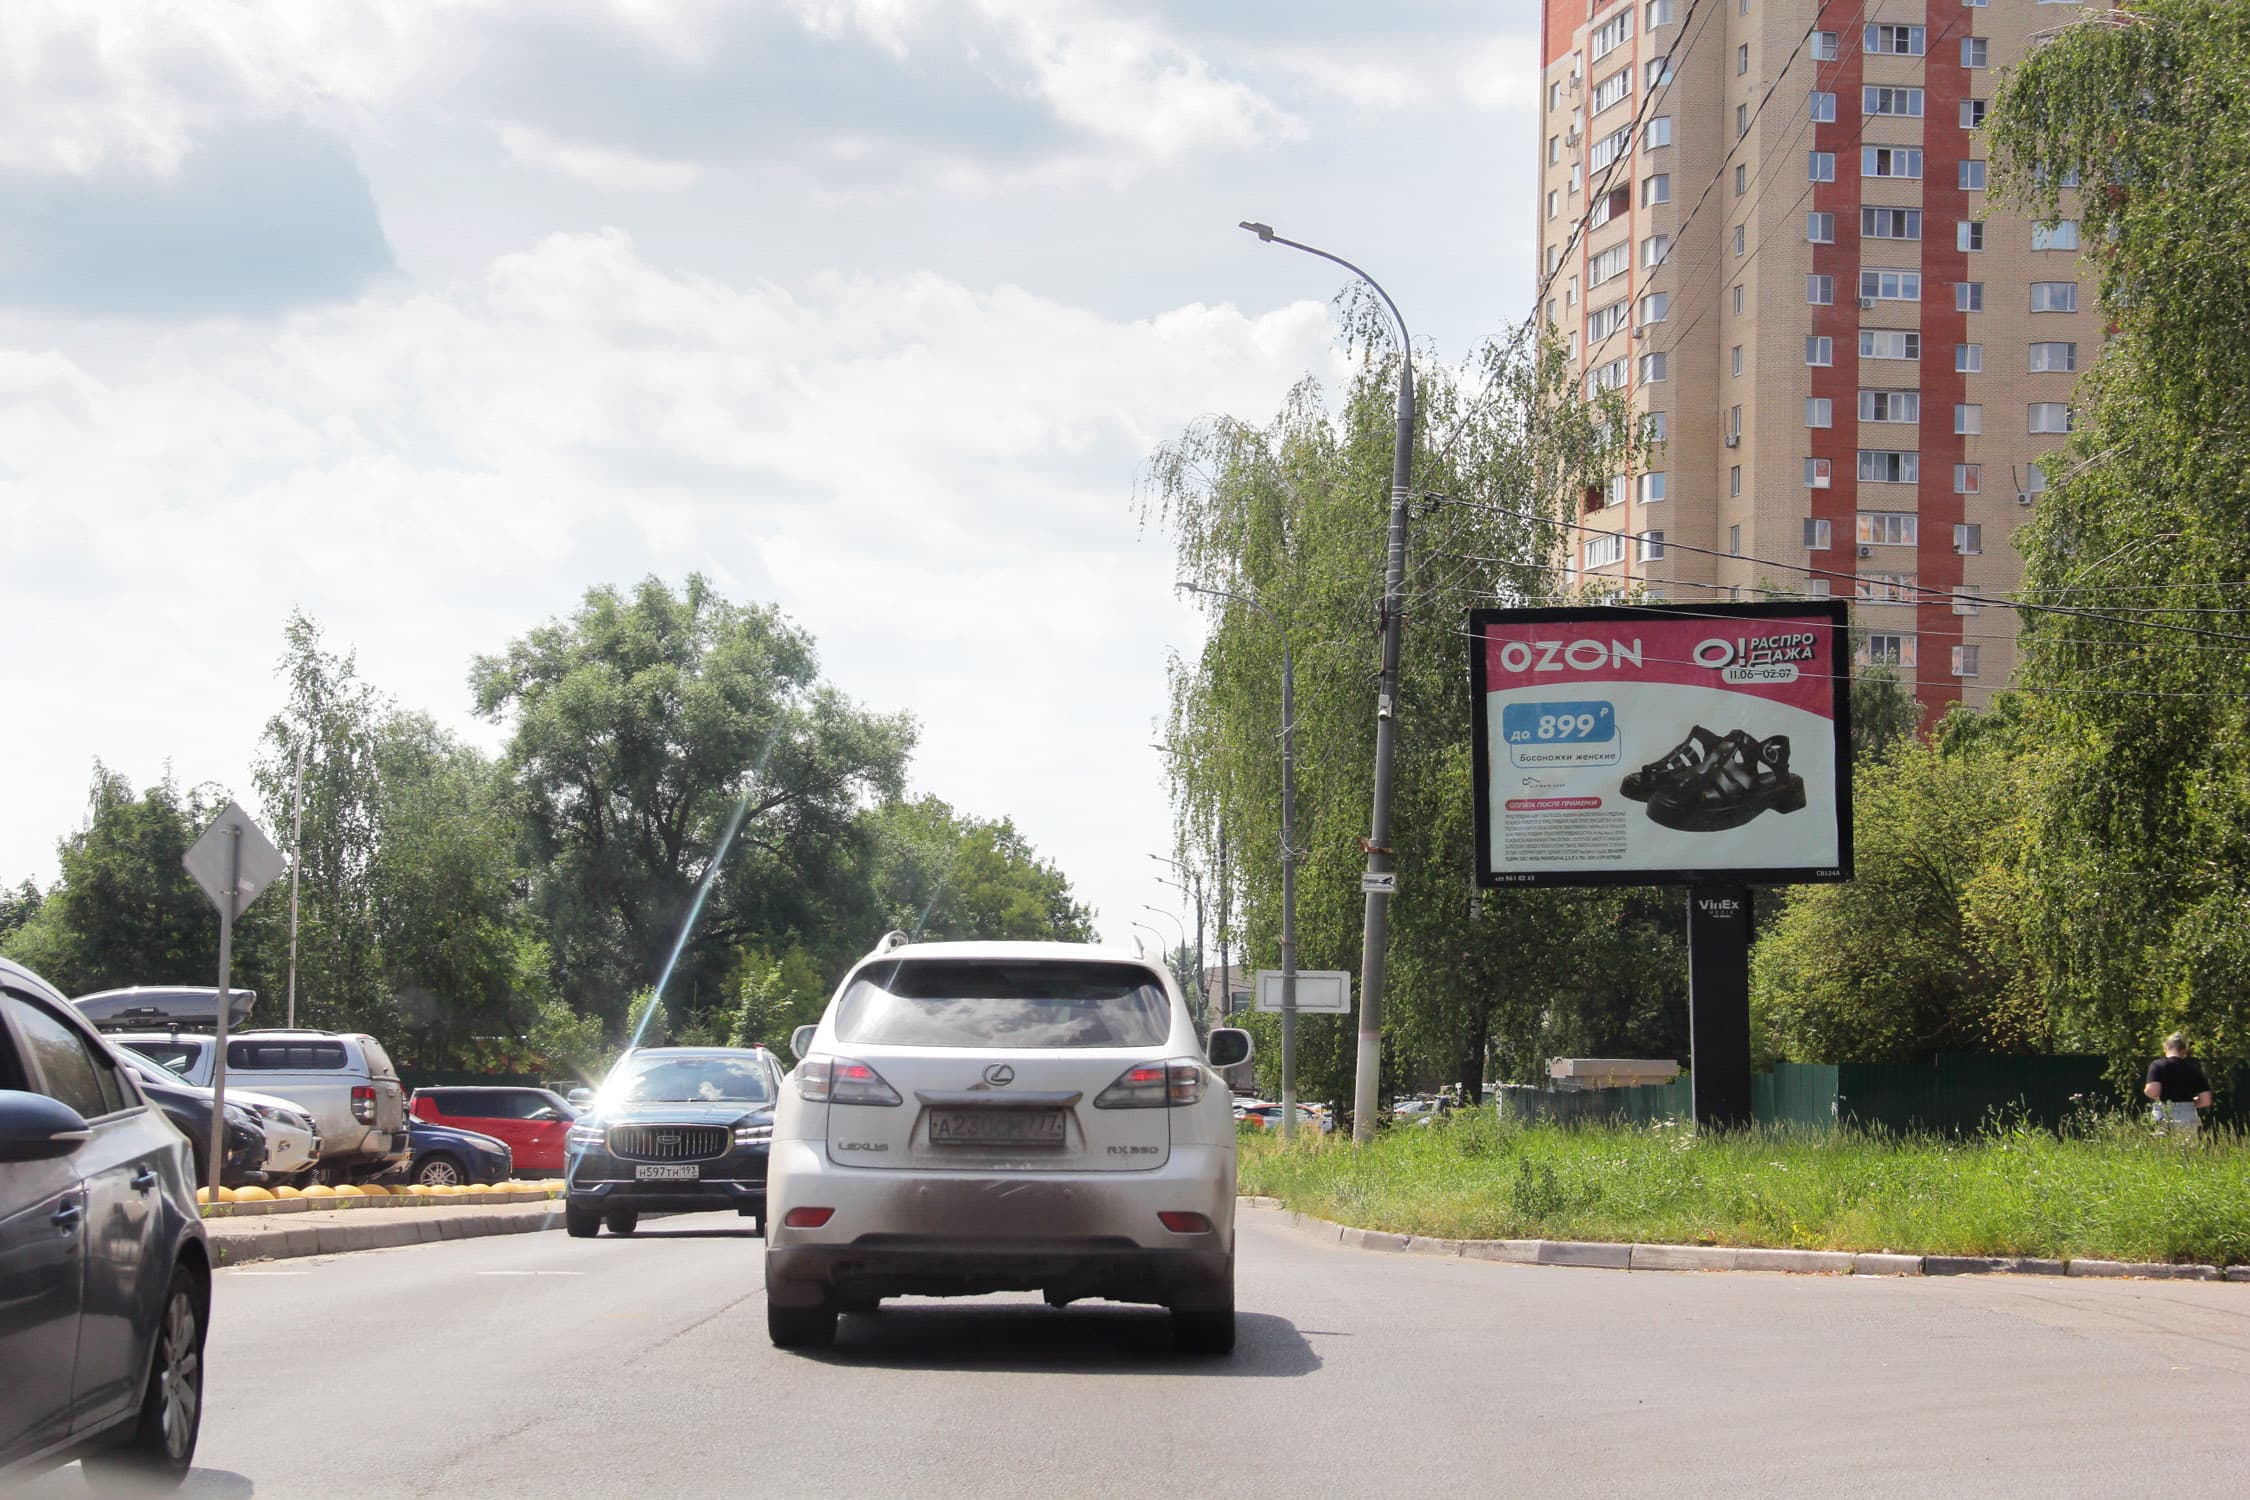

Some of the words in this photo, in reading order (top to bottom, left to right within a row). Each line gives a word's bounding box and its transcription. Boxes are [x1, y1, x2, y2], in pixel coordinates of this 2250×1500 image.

[1750, 632, 1815, 650] РАСПРО
[1500, 638, 1643, 673] OZON
[1748, 647, 1814, 667] ДАЖА
[1510, 730, 1531, 742] до
[1537, 713, 1596, 739] 899
[1519, 753, 1573, 762] Босоножки
[1575, 753, 1617, 761] женские
[1508, 801, 1536, 809] ОПЛАТА
[1536, 800, 1560, 808] ПОСЛЕ
[1698, 899, 1740, 910] VinEx
[838, 1141, 889, 1151] LEXUS
